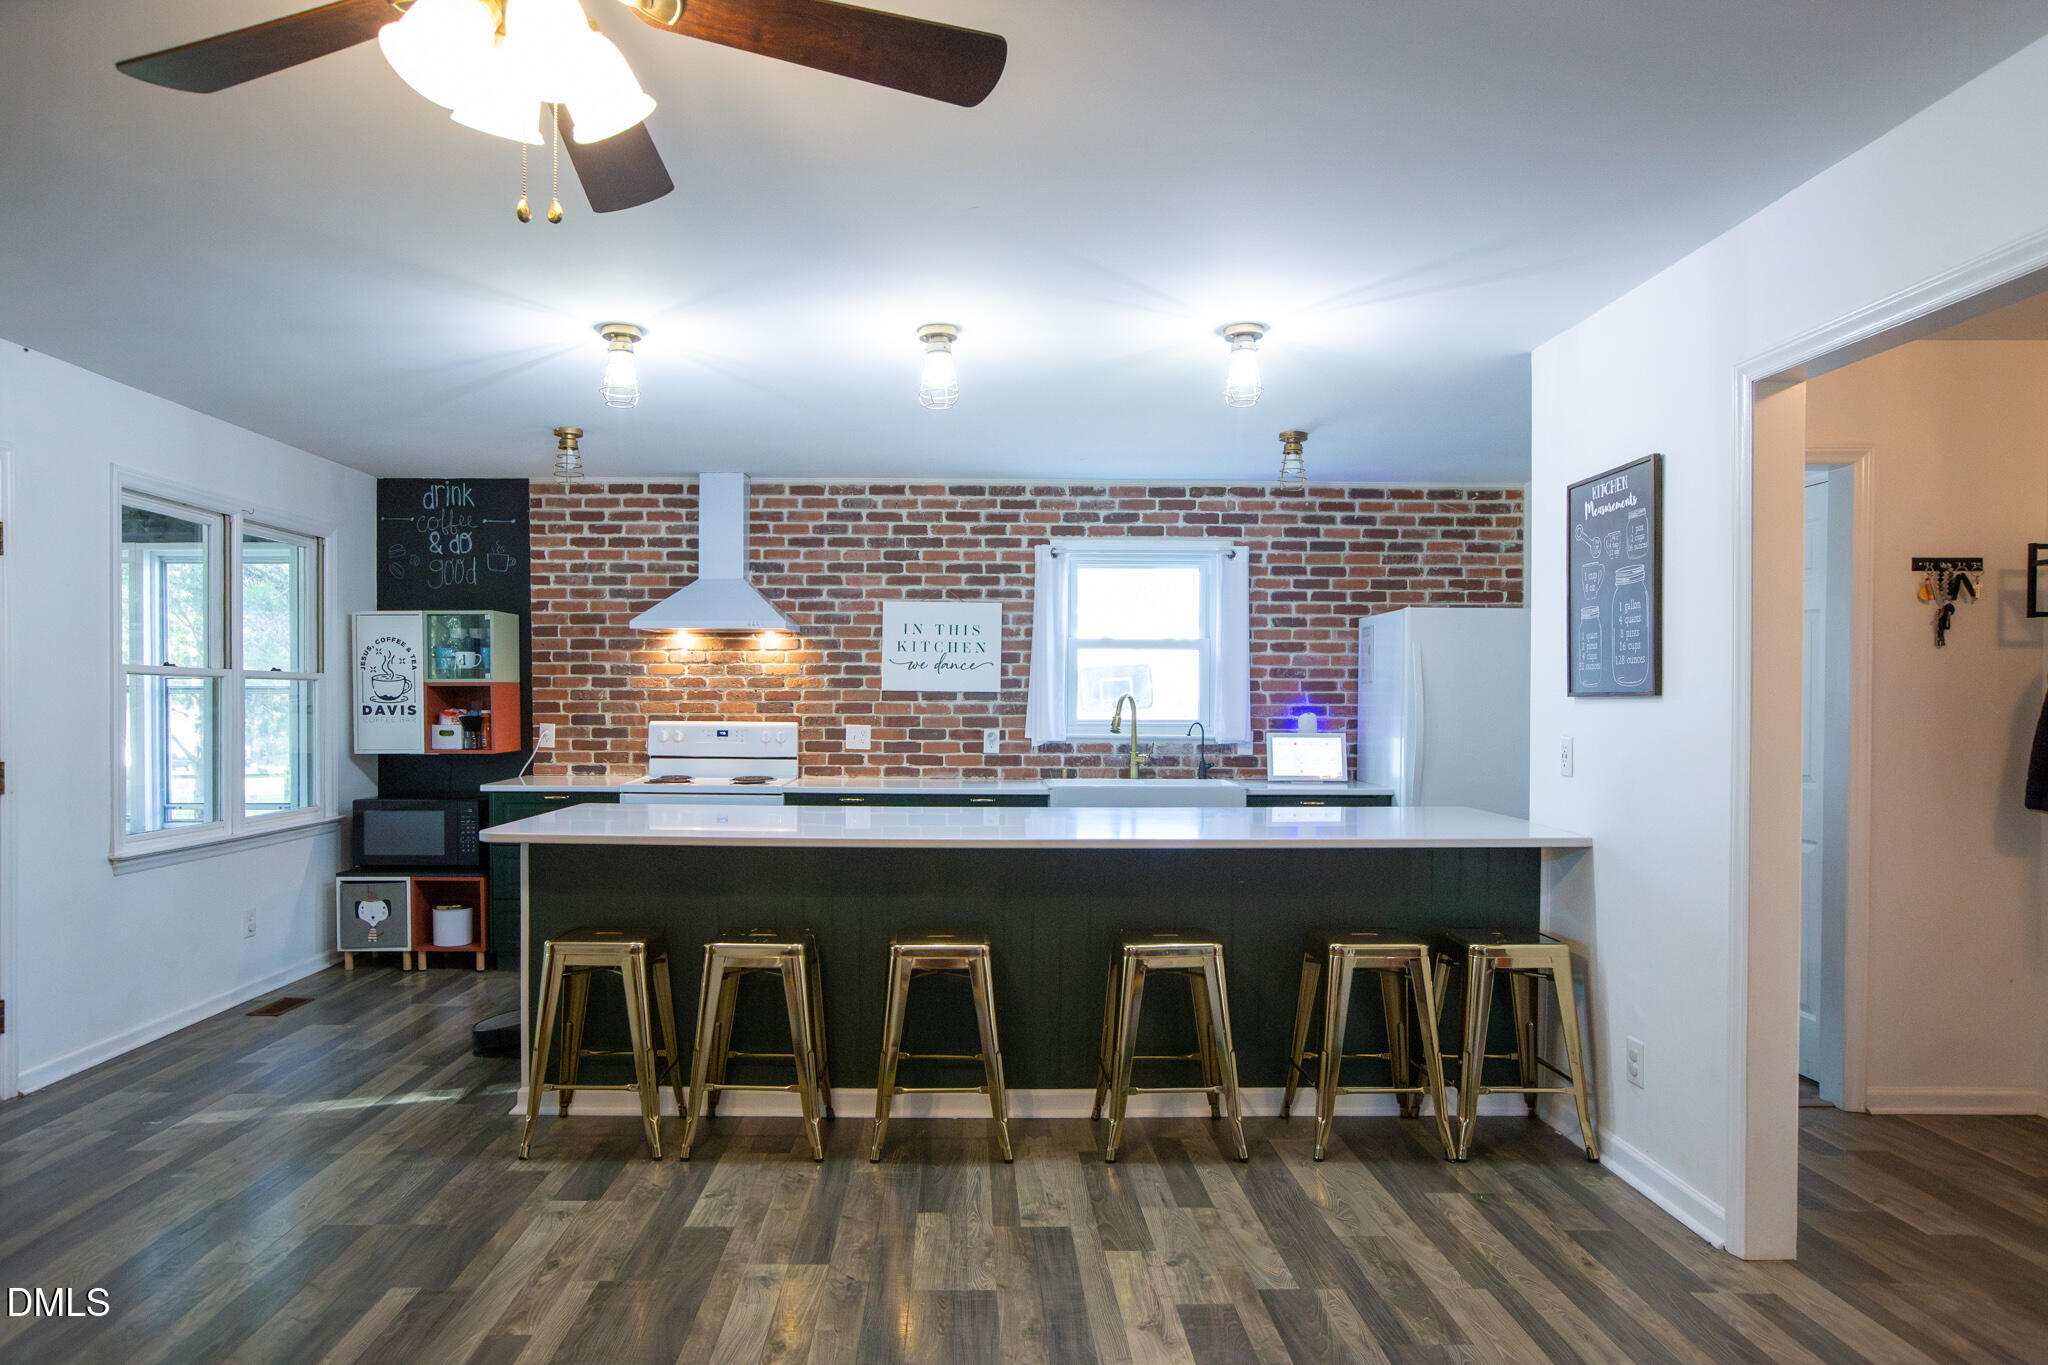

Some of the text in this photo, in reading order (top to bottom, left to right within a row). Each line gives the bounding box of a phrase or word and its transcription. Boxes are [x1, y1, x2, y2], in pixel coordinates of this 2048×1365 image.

[1592, 475, 1629, 500] KITCHEN
[423, 480, 475, 510] drink
[1584, 492, 1638, 520] Measurements
[416, 508, 480, 536] coffee
[428, 531, 473, 555] & do
[426, 556, 477, 590] good
[1624, 600, 1642, 614] gallon
[1624, 615, 1642, 628] quarts
[904, 623, 981, 636] IN THIS
[1625, 630, 1640, 640] pints
[374, 636, 407, 648] COFFEE
[897, 640, 986, 653] KITCHEN
[1628, 642, 1641, 654] cups
[889, 652, 994, 675] we dance
[1616, 655, 1646, 665] 128 ounces
[362, 705, 417, 716] DAVIS
